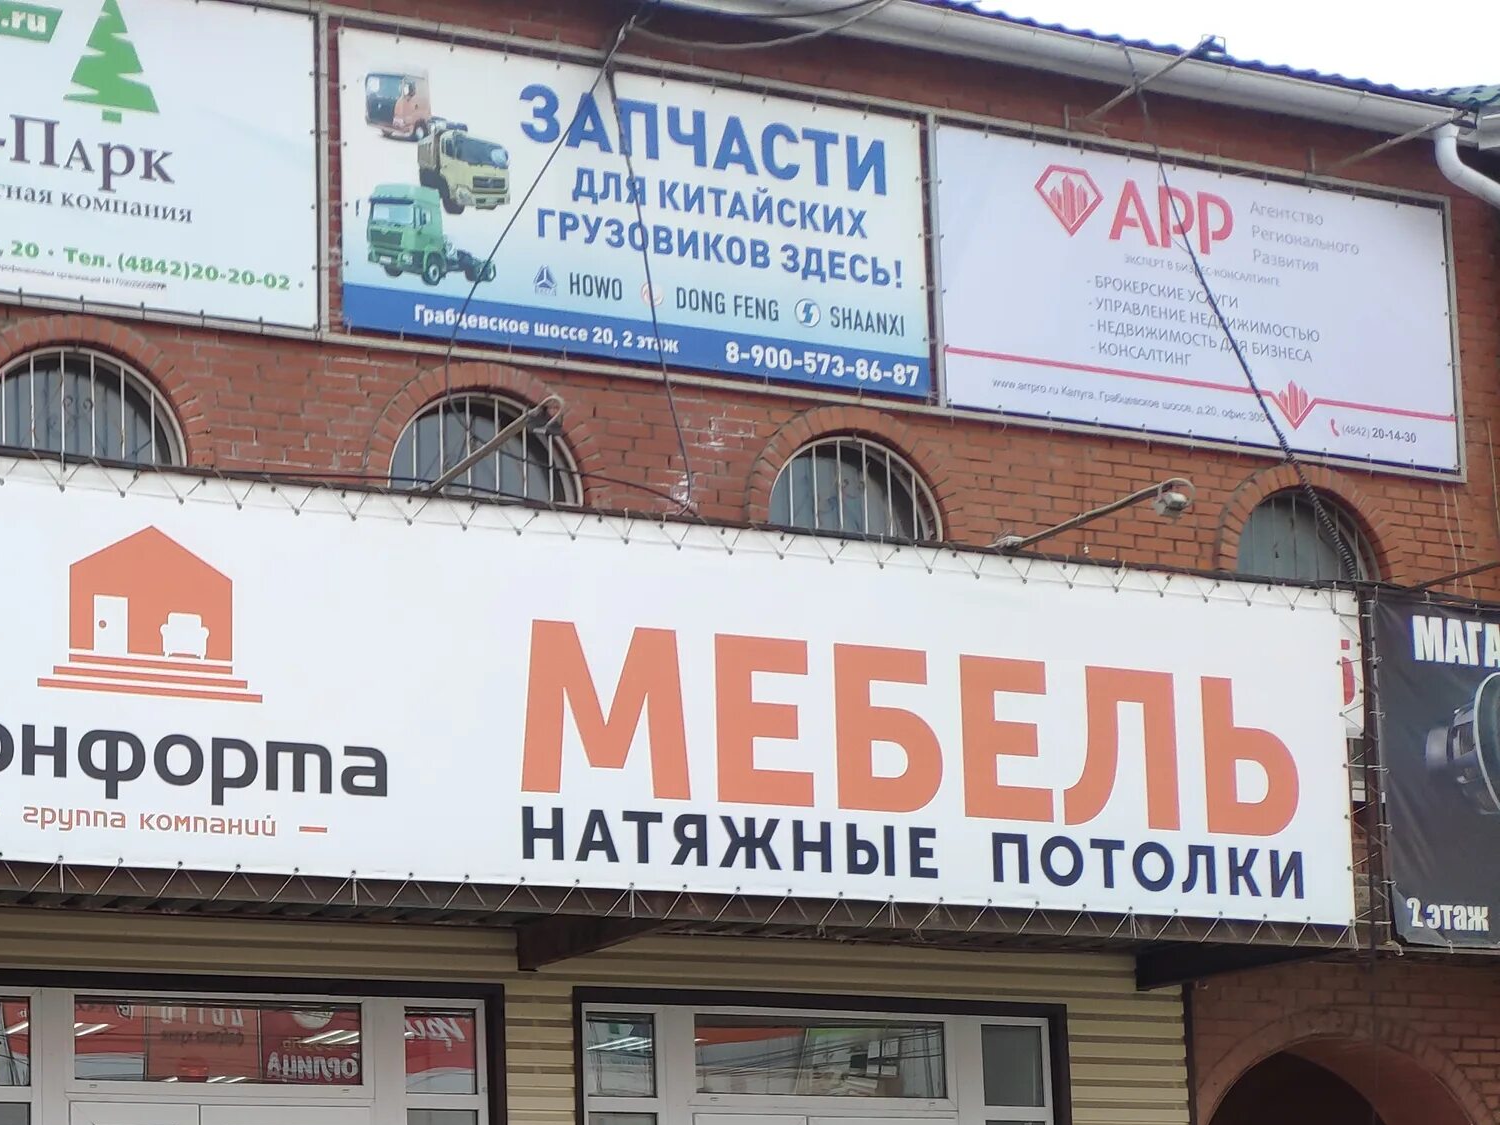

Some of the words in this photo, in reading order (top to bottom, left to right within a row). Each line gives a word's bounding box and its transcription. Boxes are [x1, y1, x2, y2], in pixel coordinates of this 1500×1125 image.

[518, 83, 888, 196] ЗАПЧАСТИ
[61, 192, 194, 223] компания
[572, 167, 646, 205] ДЛЯ
[659, 178, 868, 240] КИТАЙСКИХ
[1250, 201, 1324, 226] Агентство
[536, 208, 771, 270] ГРУЗОВИКОВ
[779, 243, 904, 289] ЗДЕСЬ!
[1251, 225, 1360, 256] Регионального
[1252, 248, 1319, 272] Развития
[10, 240, 40, 258] 20
[63, 246, 112, 268] Тел.
[117, 252, 291, 290] (4842)20-20-02
[569, 272, 623, 301] HOWO
[676, 286, 726, 317] DONG
[734, 294, 780, 322] FENG
[829, 305, 906, 338] SHAANXI
[1095, 275, 1184, 301] БРОКЕРСКИЕ
[413, 304, 530, 335] Грабцевское
[533, 319, 589, 342] шоссе
[591, 326, 619, 350] 20,
[622, 330, 633, 348] 2
[636, 334, 681, 354] этаж
[1096, 298, 1187, 323] УПРАВЛЕНИЕ
[1097, 319, 1217, 348] НЕДВИЖИМОСТЬ
[1252, 341, 1313, 363] БИЗНЕСА
[1098, 341, 1192, 365] КОНСАЛТИНГ
[724, 340, 921, 387] 8-900-573-86-87
[1372, 427, 1417, 443] 20-14-30
[520, 618, 1301, 837] МЕБЕЛЬ
[22, 806, 127, 831] группа
[140, 813, 277, 838] компаний
[521, 806, 939, 879] НАТЯЖНЫЕ
[992, 832, 1304, 900] ПОТОЛКИ
[1406, 897, 1424, 929] 2
[1425, 902, 1490, 932] этаж
